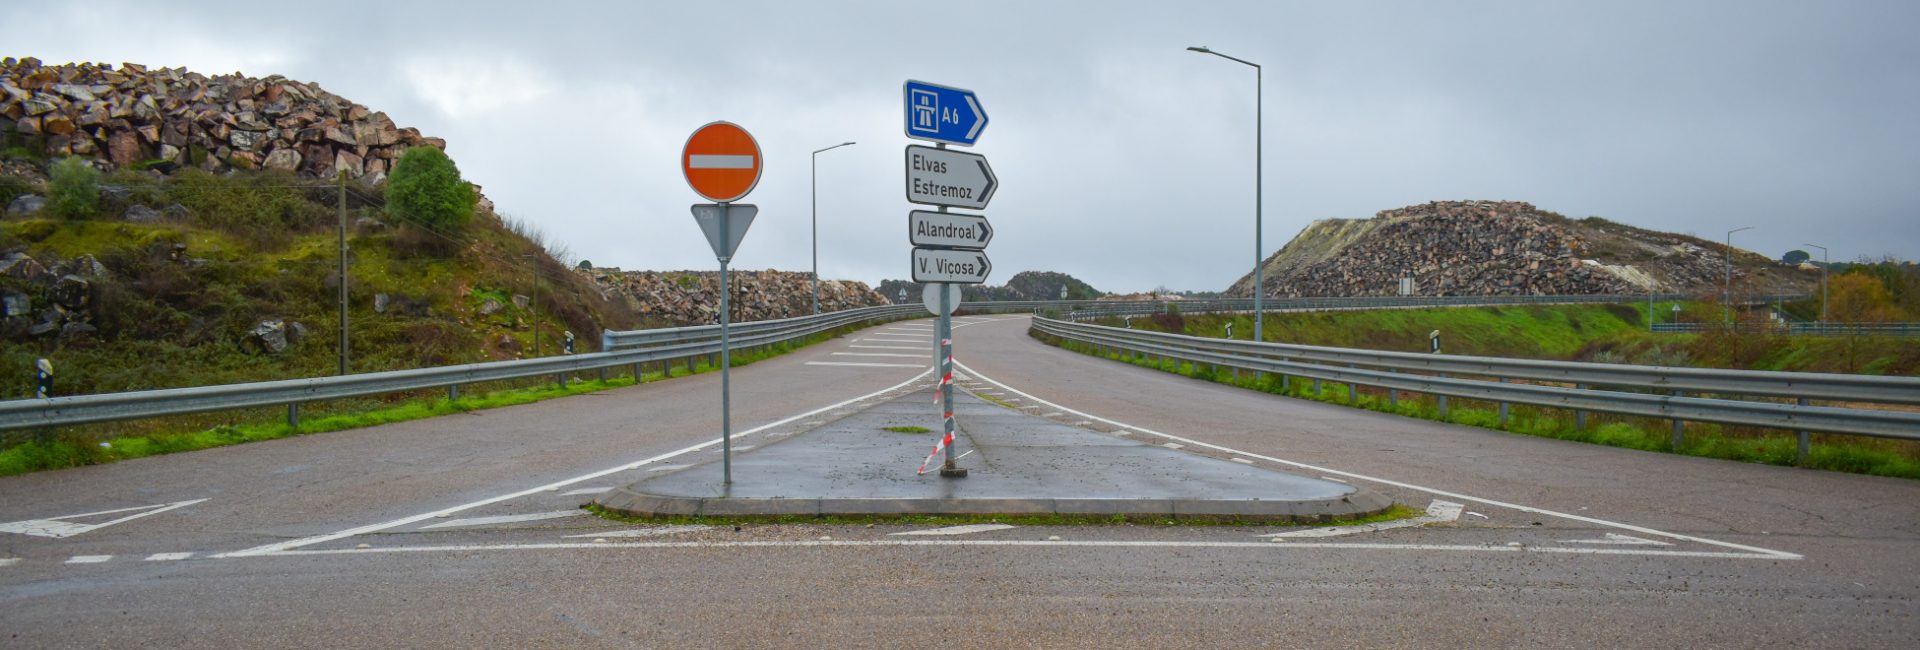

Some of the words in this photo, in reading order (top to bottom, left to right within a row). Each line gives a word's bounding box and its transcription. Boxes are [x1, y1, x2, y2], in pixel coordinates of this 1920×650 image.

[913, 154, 947, 174] Elvas
[914, 178, 972, 199] Estremoz
[917, 221, 976, 239] Alandroal
[919, 257, 932, 274] V.
[936, 257, 974, 276] Viçosa
